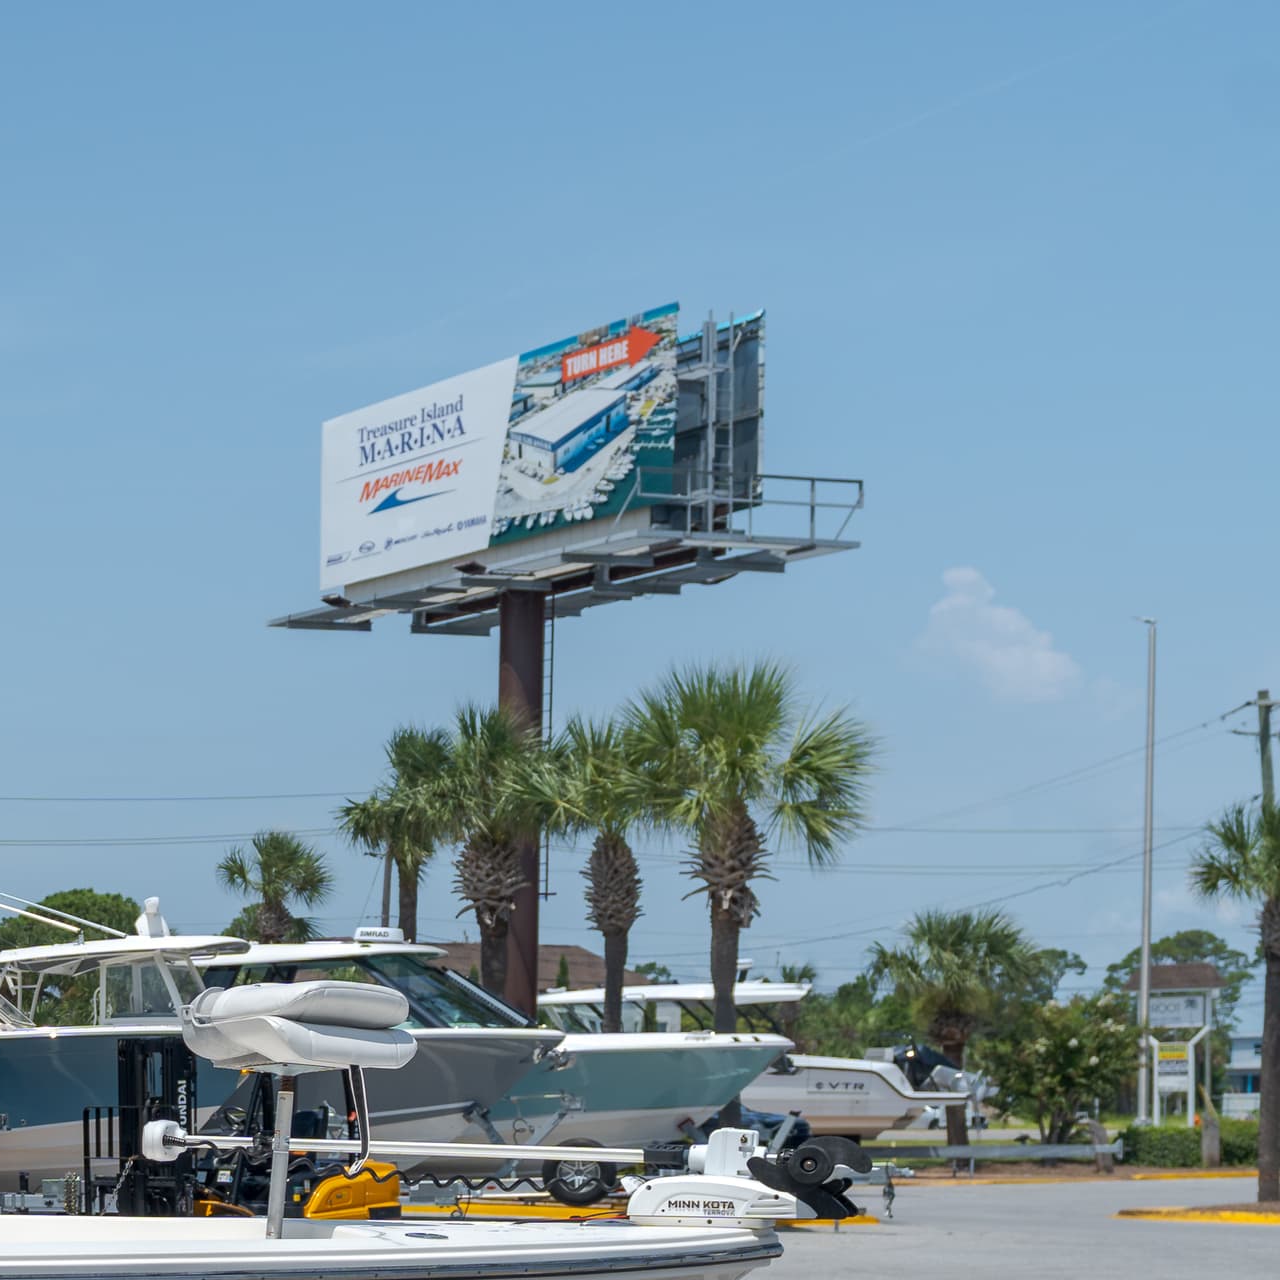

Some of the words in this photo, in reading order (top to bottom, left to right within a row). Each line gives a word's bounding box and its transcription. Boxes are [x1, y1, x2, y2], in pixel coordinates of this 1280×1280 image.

[566, 349, 598, 377] TURN
[599, 339, 629, 367] HERE
[357, 414, 418, 443] Treasure
[421, 393, 464, 424] Island
[178, 1079, 188, 1128] UNDAI
[668, 1200, 700, 1209] MINN
[703, 1200, 735, 1209] KOTA
